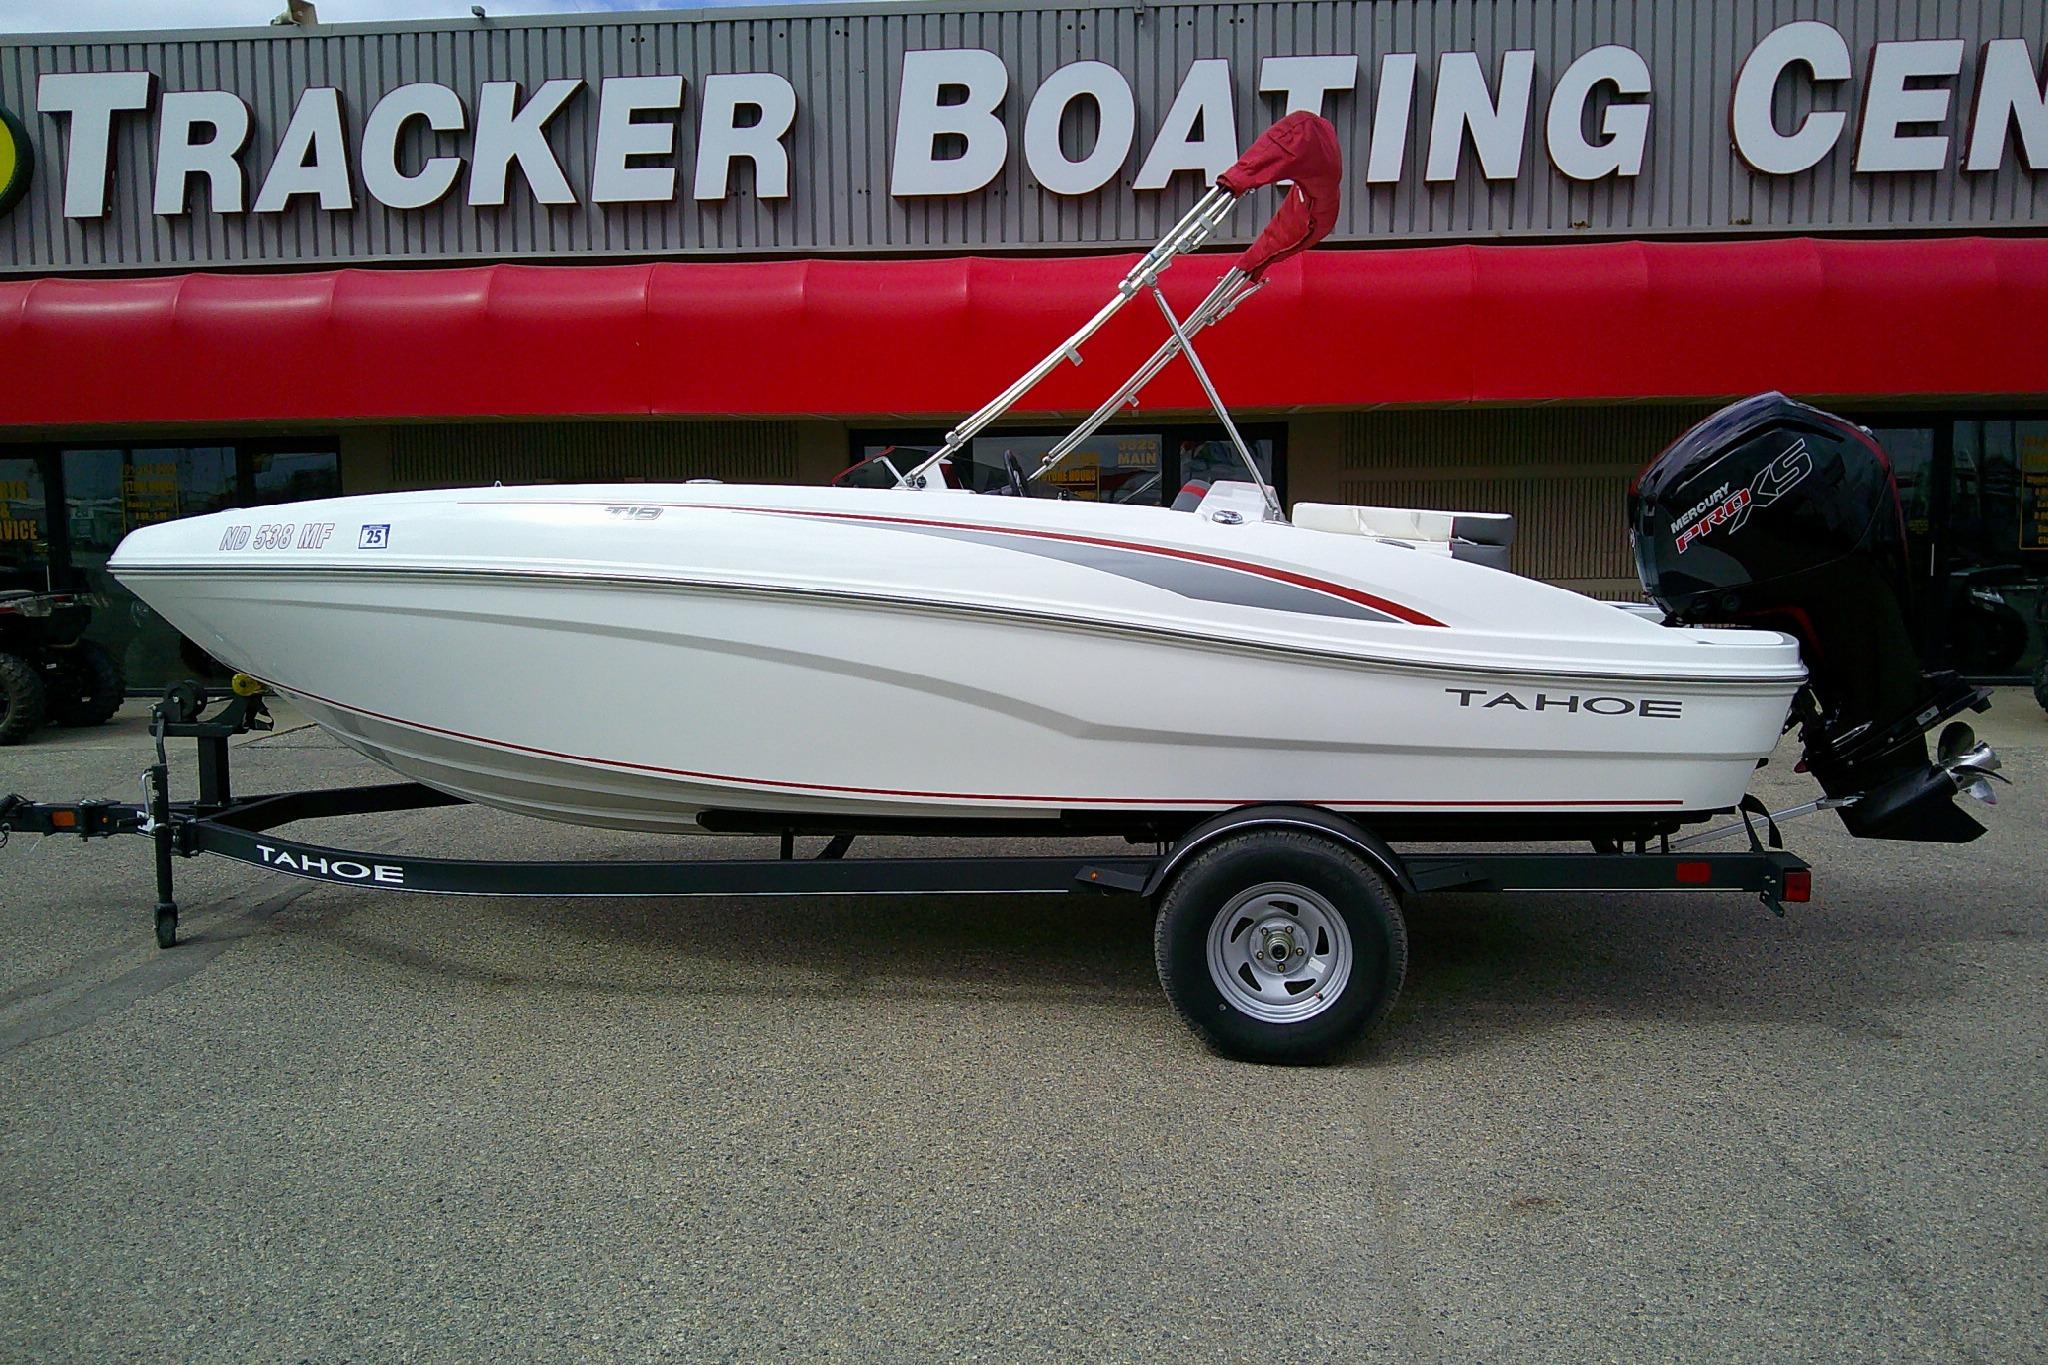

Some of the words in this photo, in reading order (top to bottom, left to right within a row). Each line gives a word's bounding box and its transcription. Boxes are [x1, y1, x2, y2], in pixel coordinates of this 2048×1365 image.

[37, 70, 798, 218] TRACKER
[891, 44, 1652, 196] BOATING
[1731, 20, 2048, 174] CEN
[1117, 453, 1157, 465] MAIN
[1670, 481, 1730, 534] MERCURY
[0, 519, 38, 540] VICE
[219, 525, 251, 551] ND
[253, 523, 295, 550] 538
[366, 529, 382, 544] 25
[1445, 688, 1683, 719] TAHOE
[256, 844, 404, 884] TAHOE
